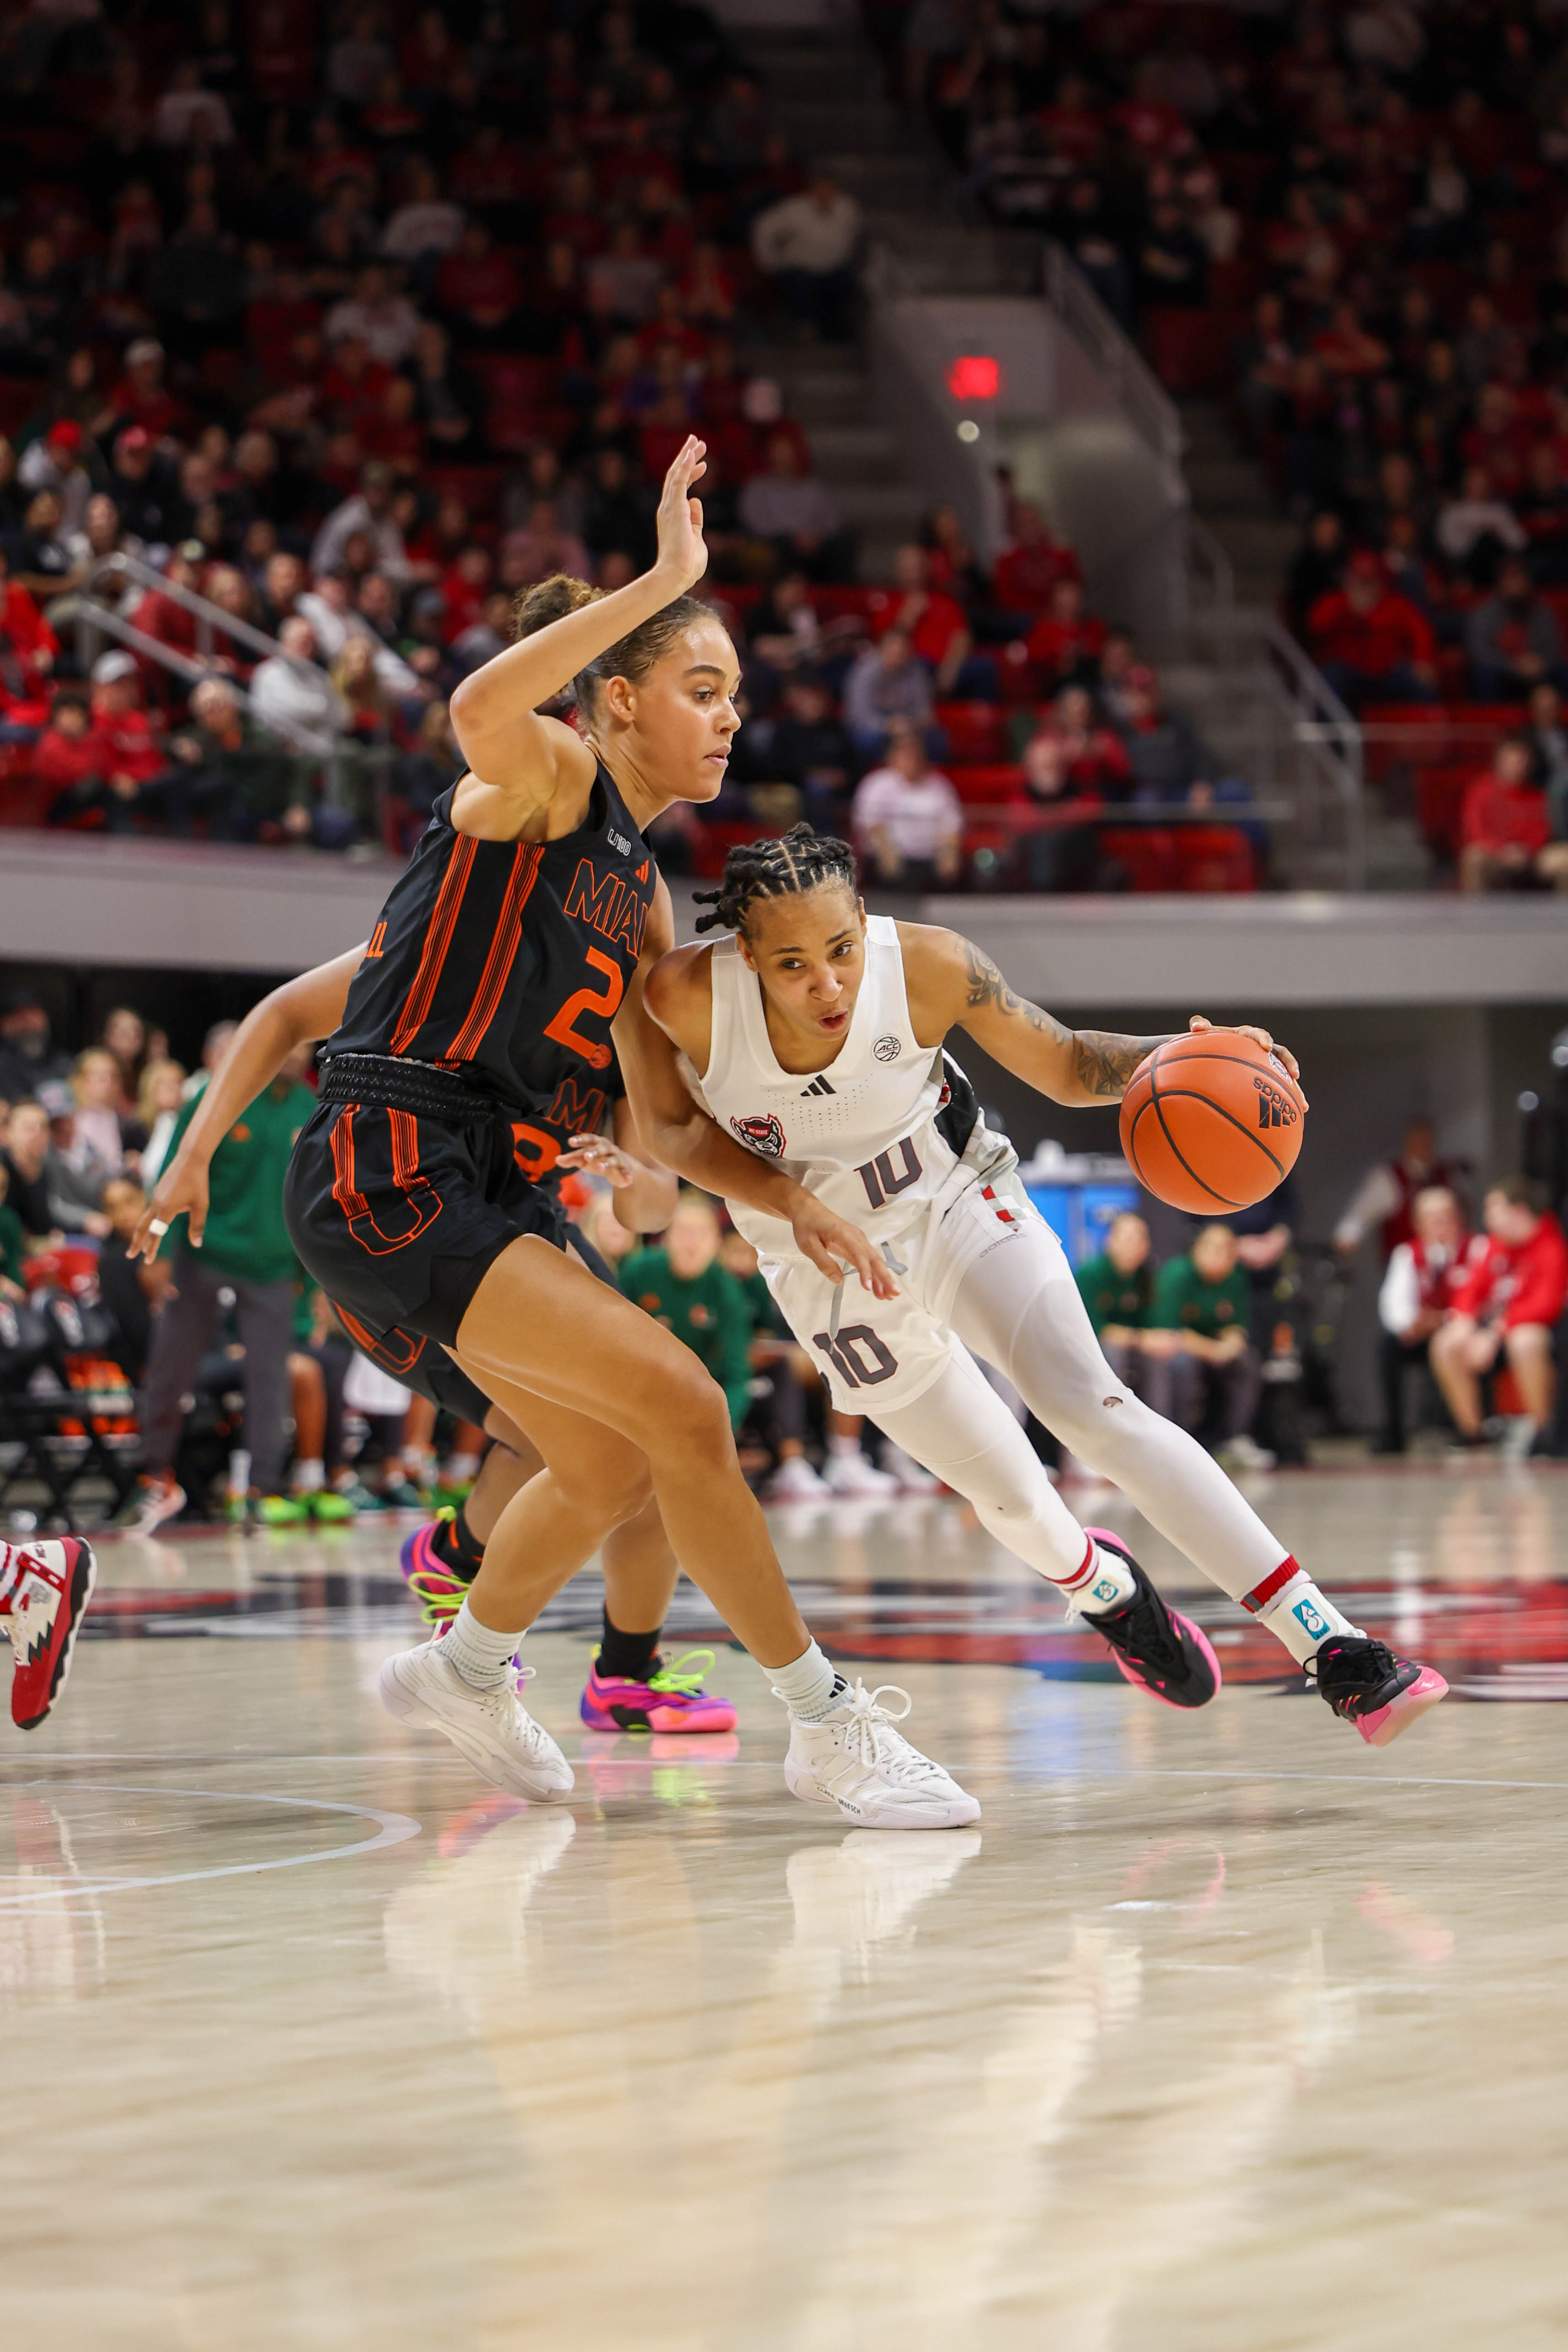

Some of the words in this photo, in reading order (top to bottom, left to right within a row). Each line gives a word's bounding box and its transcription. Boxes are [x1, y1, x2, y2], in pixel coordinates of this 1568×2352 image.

[543, 945, 624, 1060] 2
[877, 1042, 899, 1052] ACC
[1253, 1077, 1296, 1123] adidas
[853, 1136, 923, 1209] 10
[812, 1324, 899, 1388] 10
